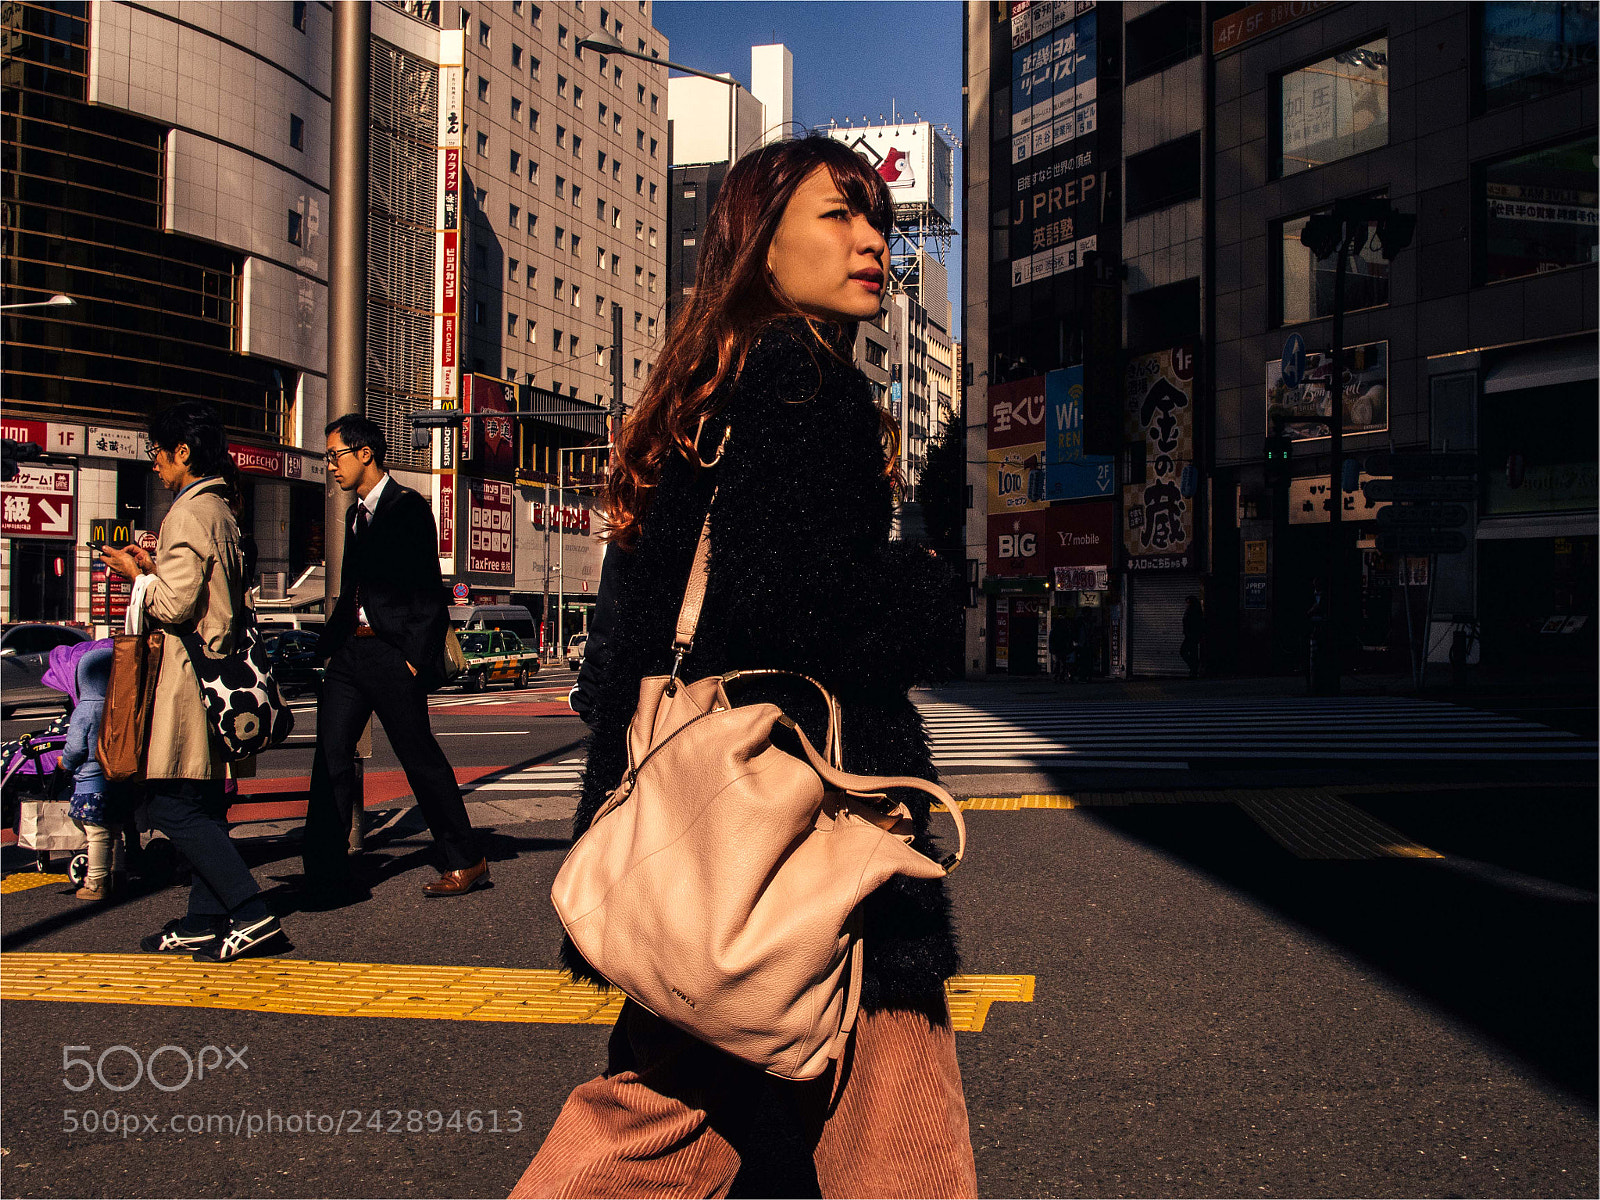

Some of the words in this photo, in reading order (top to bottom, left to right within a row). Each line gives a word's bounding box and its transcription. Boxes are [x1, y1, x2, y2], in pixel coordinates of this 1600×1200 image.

[1021, 53, 1087, 96] ツーリスト
[447, 152, 457, 189] カラオケ
[1013, 200, 1024, 225] J
[1033, 174, 1096, 219] PREP
[1033, 217, 1074, 251] 英語塾
[445, 248, 455, 298] ビックカメラ
[1176, 348, 1193, 372] 1F
[504, 386, 514, 401] 3F
[993, 395, 1045, 433] 宝くじ
[59, 432, 75, 446] 1F
[1098, 465, 1110, 480] 2F
[1141, 378, 1187, 548] 金の蔵
[998, 470, 1022, 496] LOTO
[998, 533, 1037, 558] BIG
[1073, 533, 1100, 546] mobile
[471, 556, 500, 571] TaxFree
